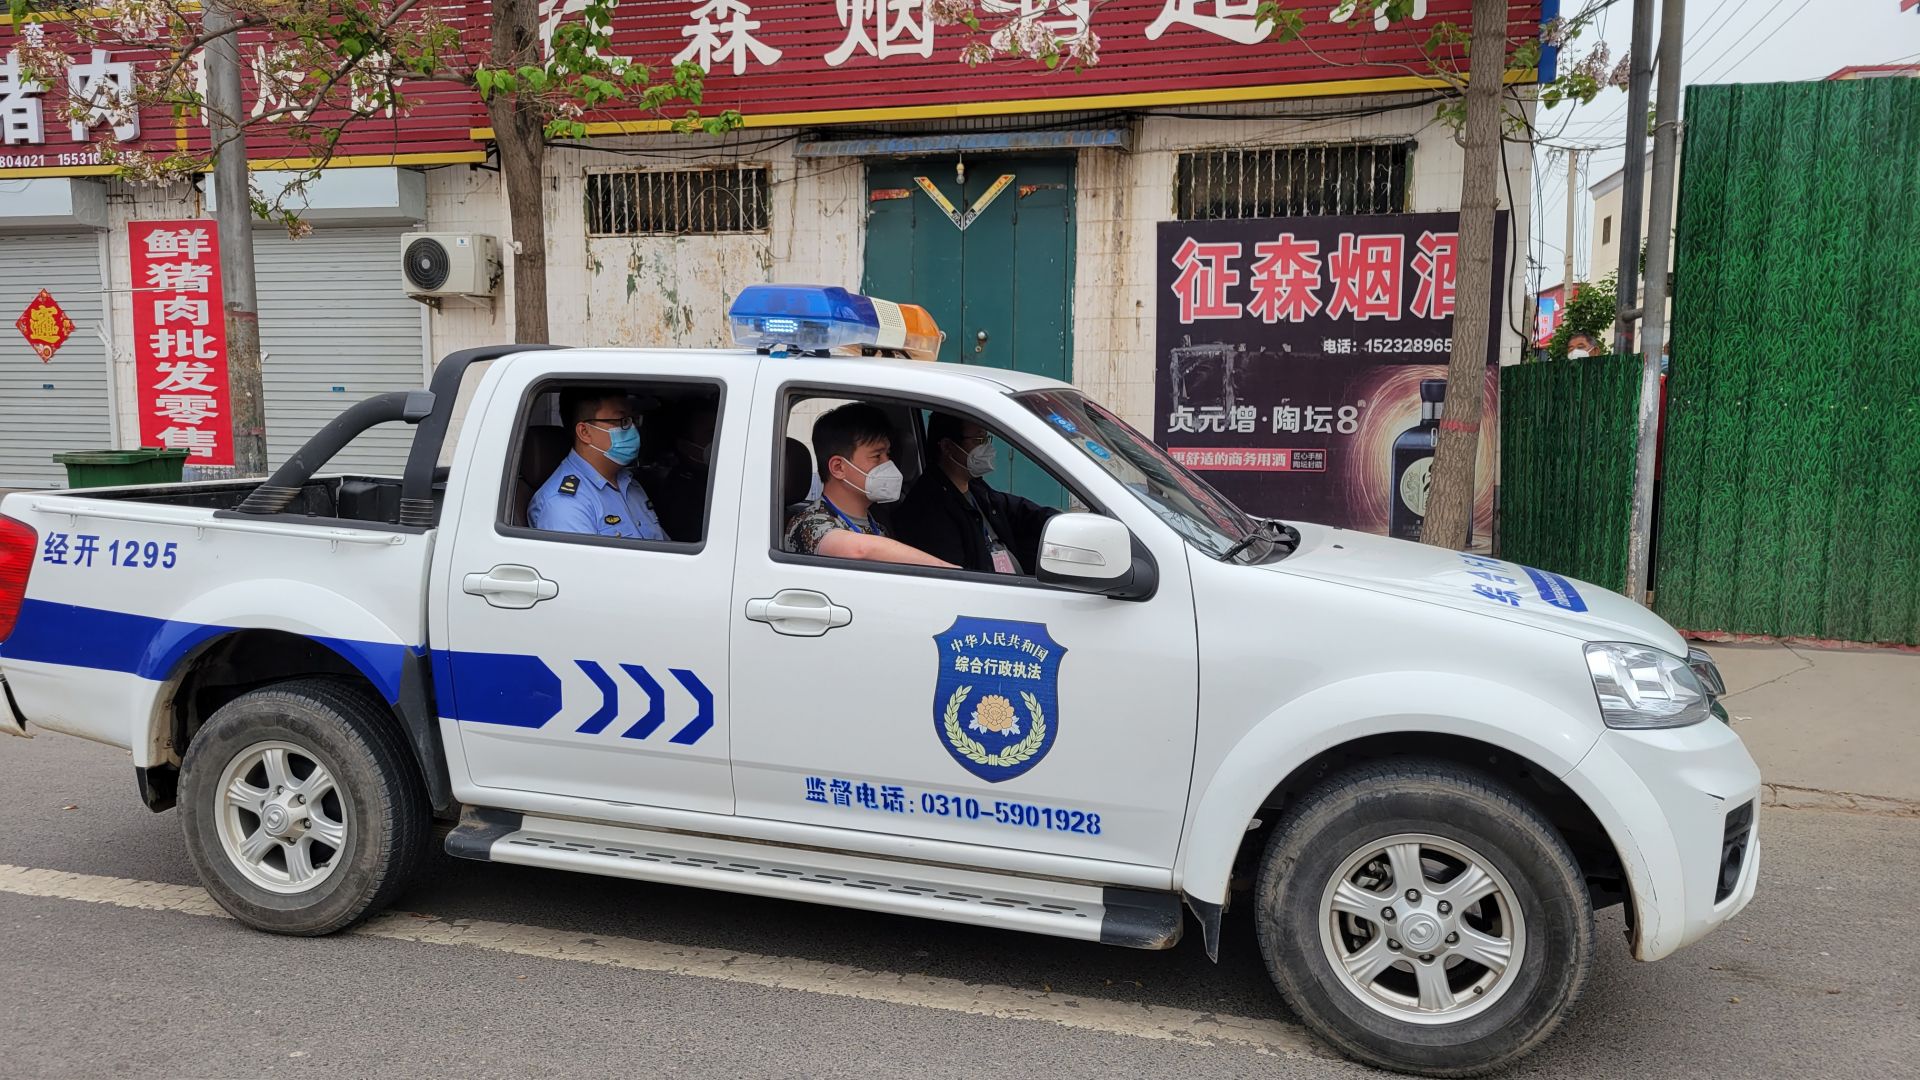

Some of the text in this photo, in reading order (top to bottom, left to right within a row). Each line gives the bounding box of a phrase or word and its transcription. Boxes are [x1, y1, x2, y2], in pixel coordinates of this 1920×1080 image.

[144, 228, 219, 458] 鲜猪肉批发零售
[950, 632, 1049, 662] 中华人民共和国
[954, 655, 1042, 680] 综合行政执法
